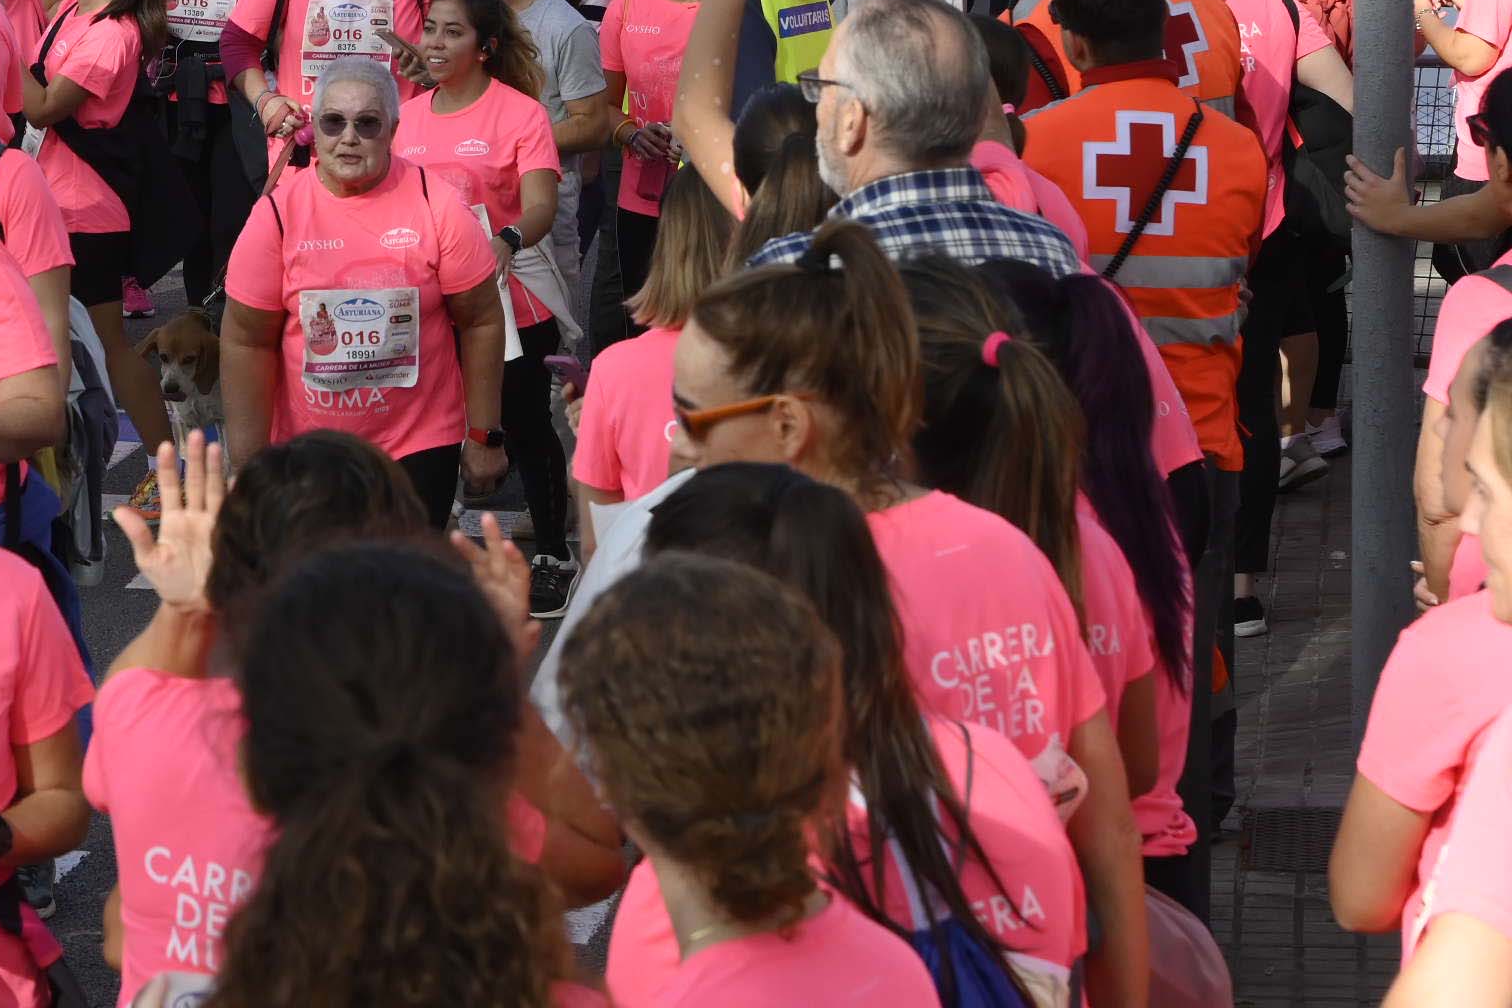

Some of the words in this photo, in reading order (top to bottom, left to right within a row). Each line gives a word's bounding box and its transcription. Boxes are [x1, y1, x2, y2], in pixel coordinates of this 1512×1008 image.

[333, 28, 362, 41] 016
[339, 308, 381, 317] ASTURIANA
[342, 331, 380, 346] 016
[346, 350, 375, 359] 18991
